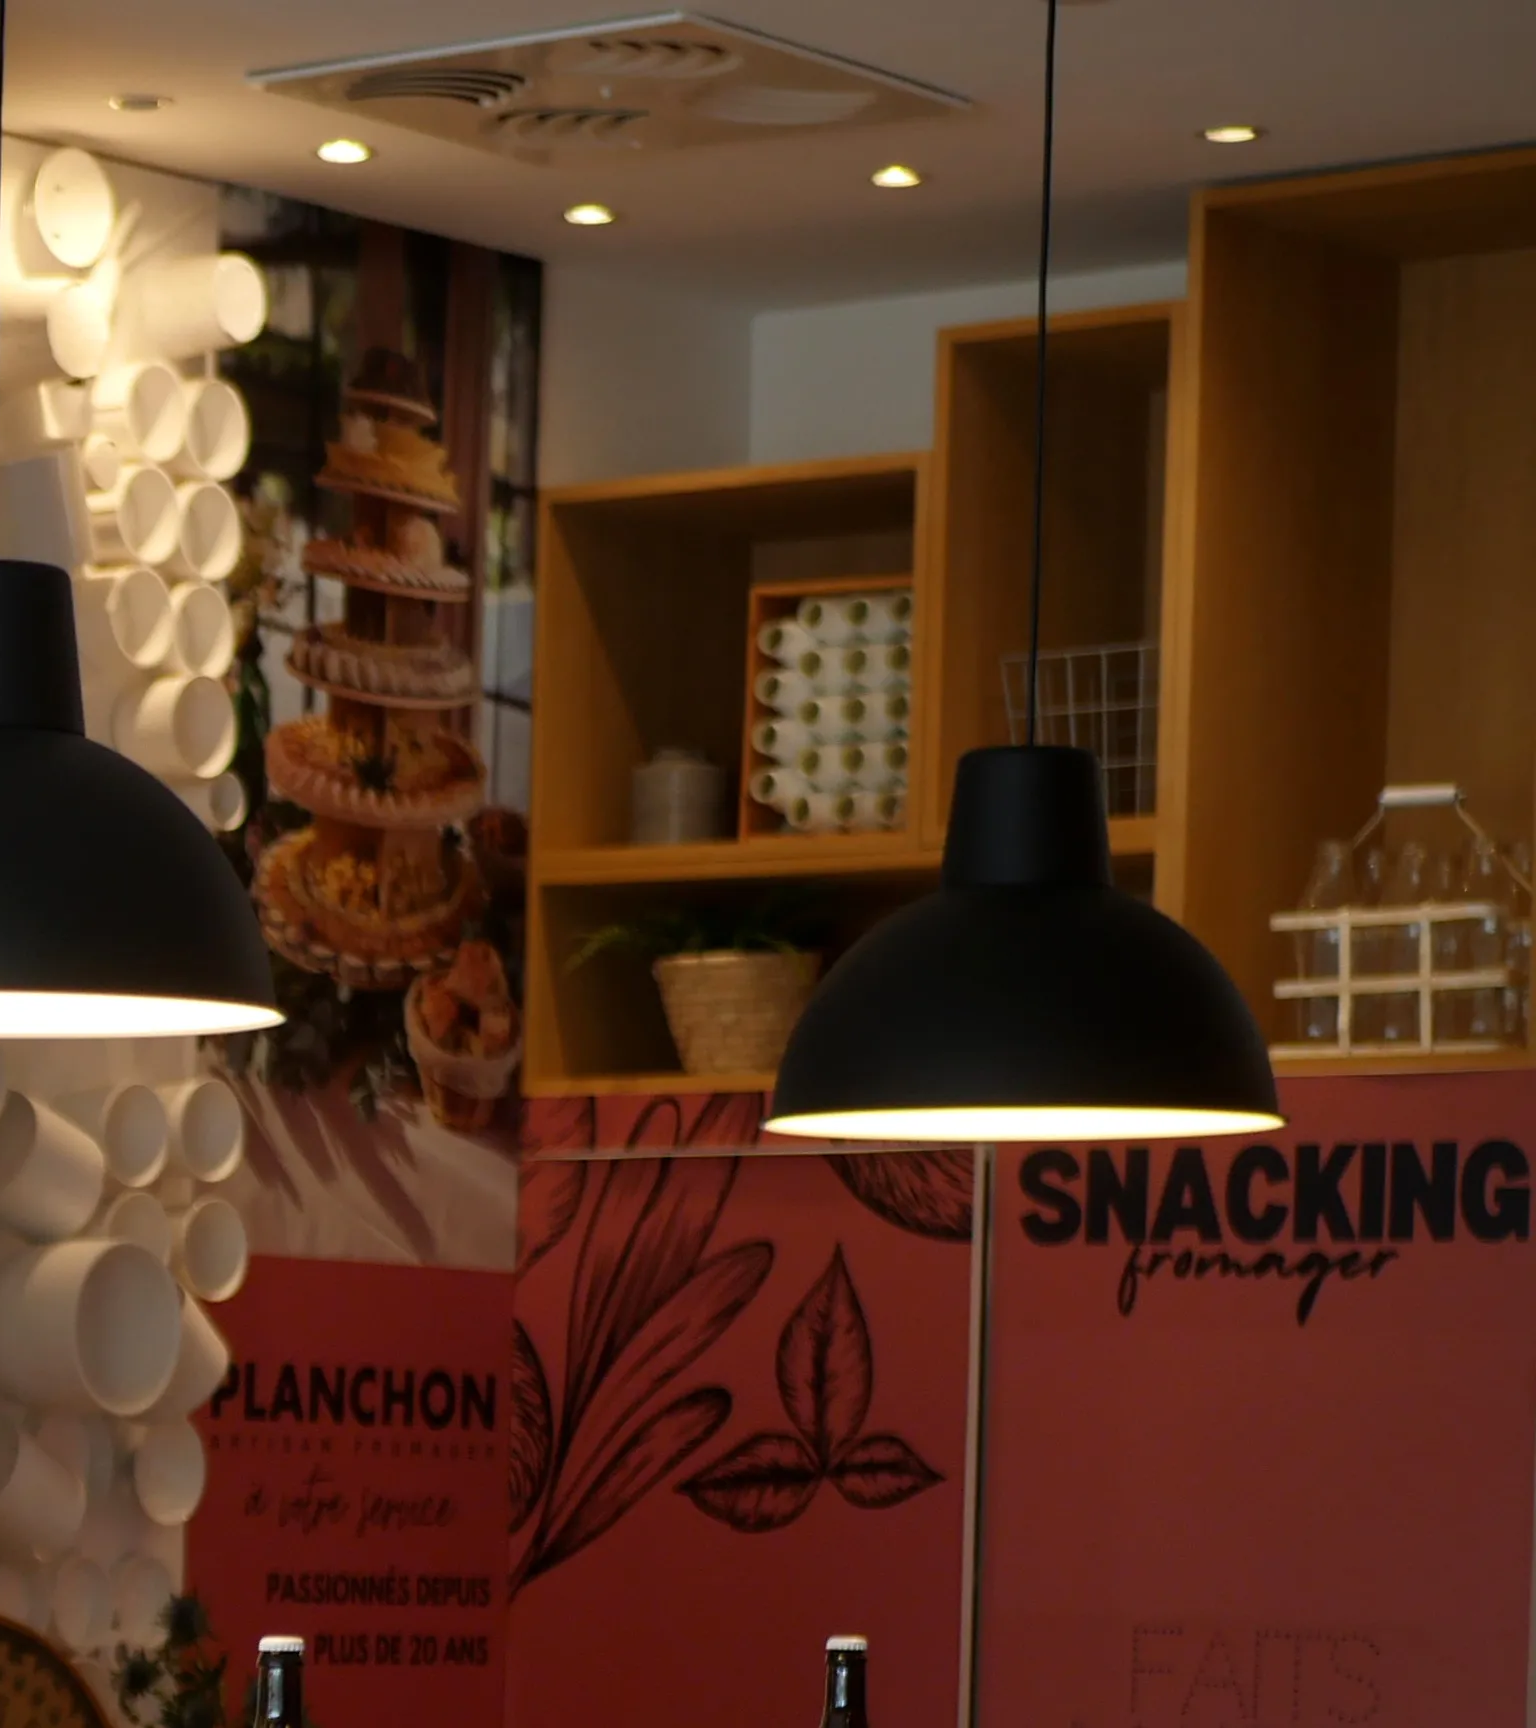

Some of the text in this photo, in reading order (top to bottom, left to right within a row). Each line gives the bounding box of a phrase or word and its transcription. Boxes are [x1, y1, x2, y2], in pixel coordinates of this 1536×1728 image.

[1018, 1138, 1534, 1246] SNACKING
[1117, 1240, 1400, 1327] fromager
[209, 1362, 497, 1432] PLANCHON
[265, 1564, 491, 1609] PASSIONNÉS DEPUIS
[313, 1634, 489, 1667] PLUS DE 20 ANS
[1130, 1623, 1382, 1725] FAITS
